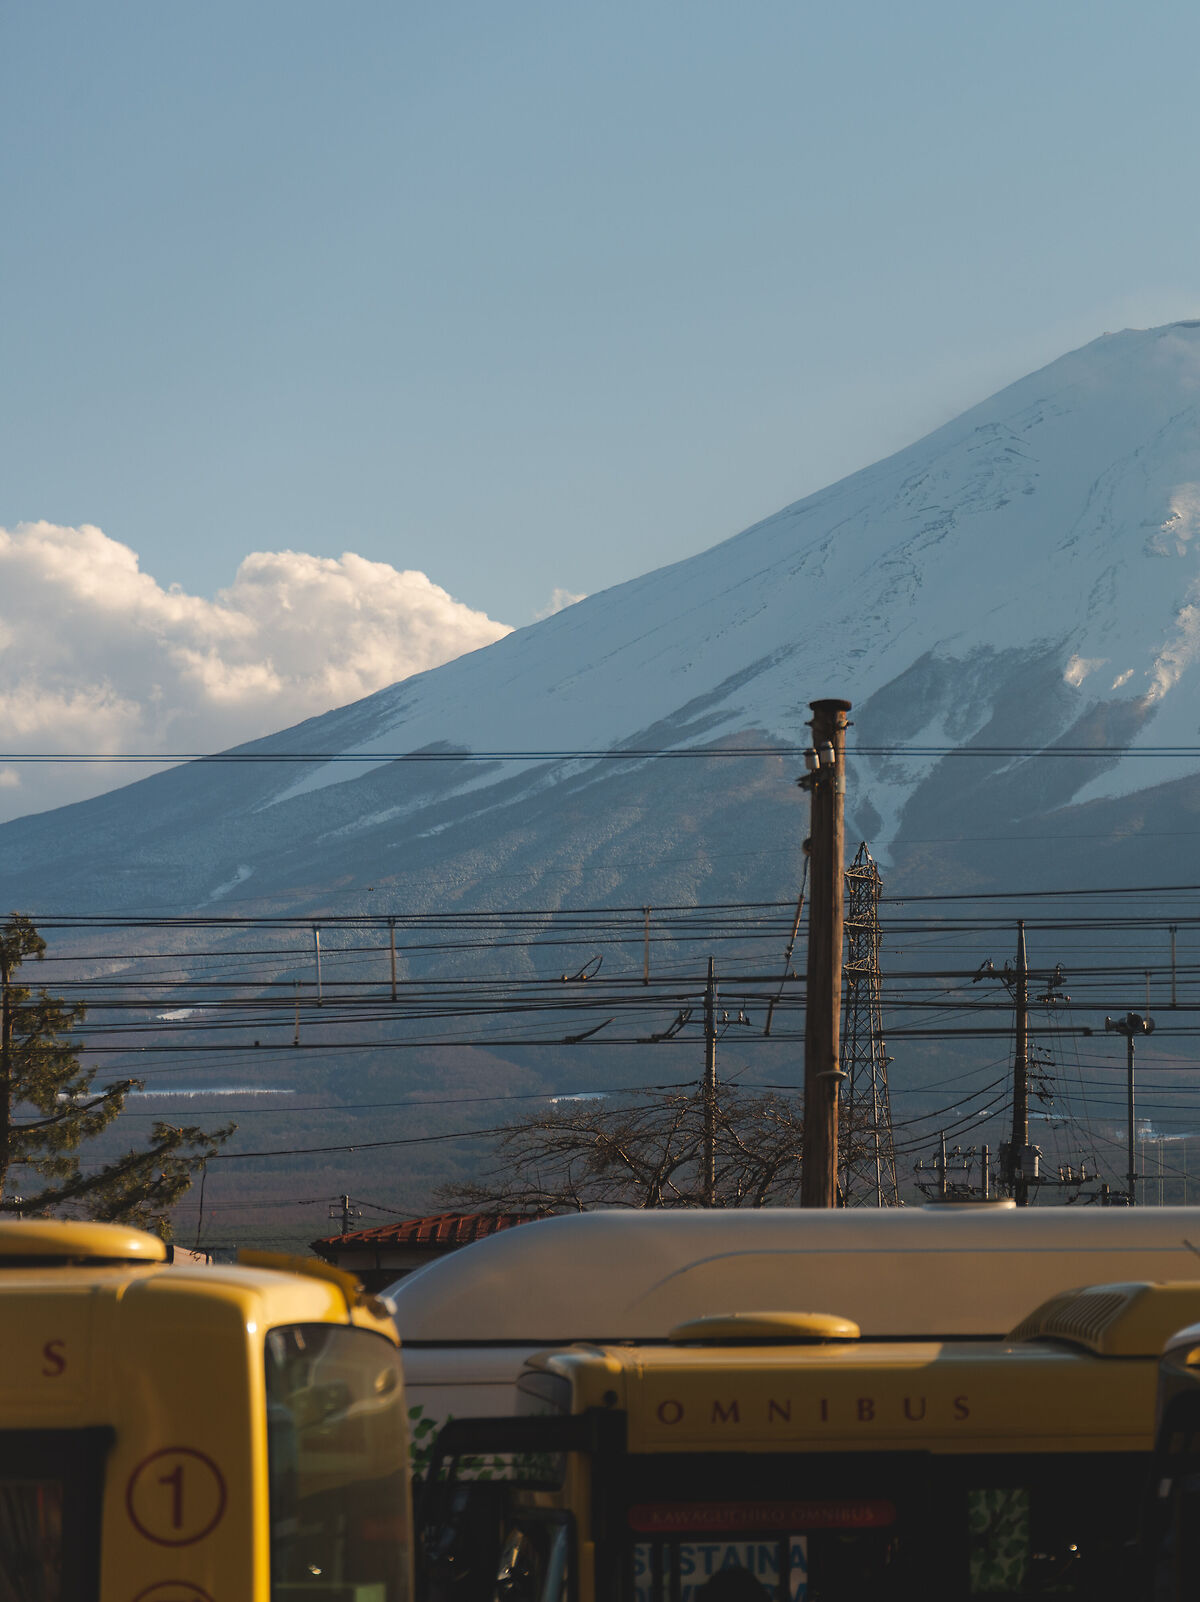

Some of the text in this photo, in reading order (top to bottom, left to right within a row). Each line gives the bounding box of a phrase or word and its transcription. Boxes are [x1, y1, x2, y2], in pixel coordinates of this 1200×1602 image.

[42, 1339, 67, 1378] S
[657, 1396, 970, 1425] OMNIBUS
[791, 1506, 875, 1522] OMNIBUS
